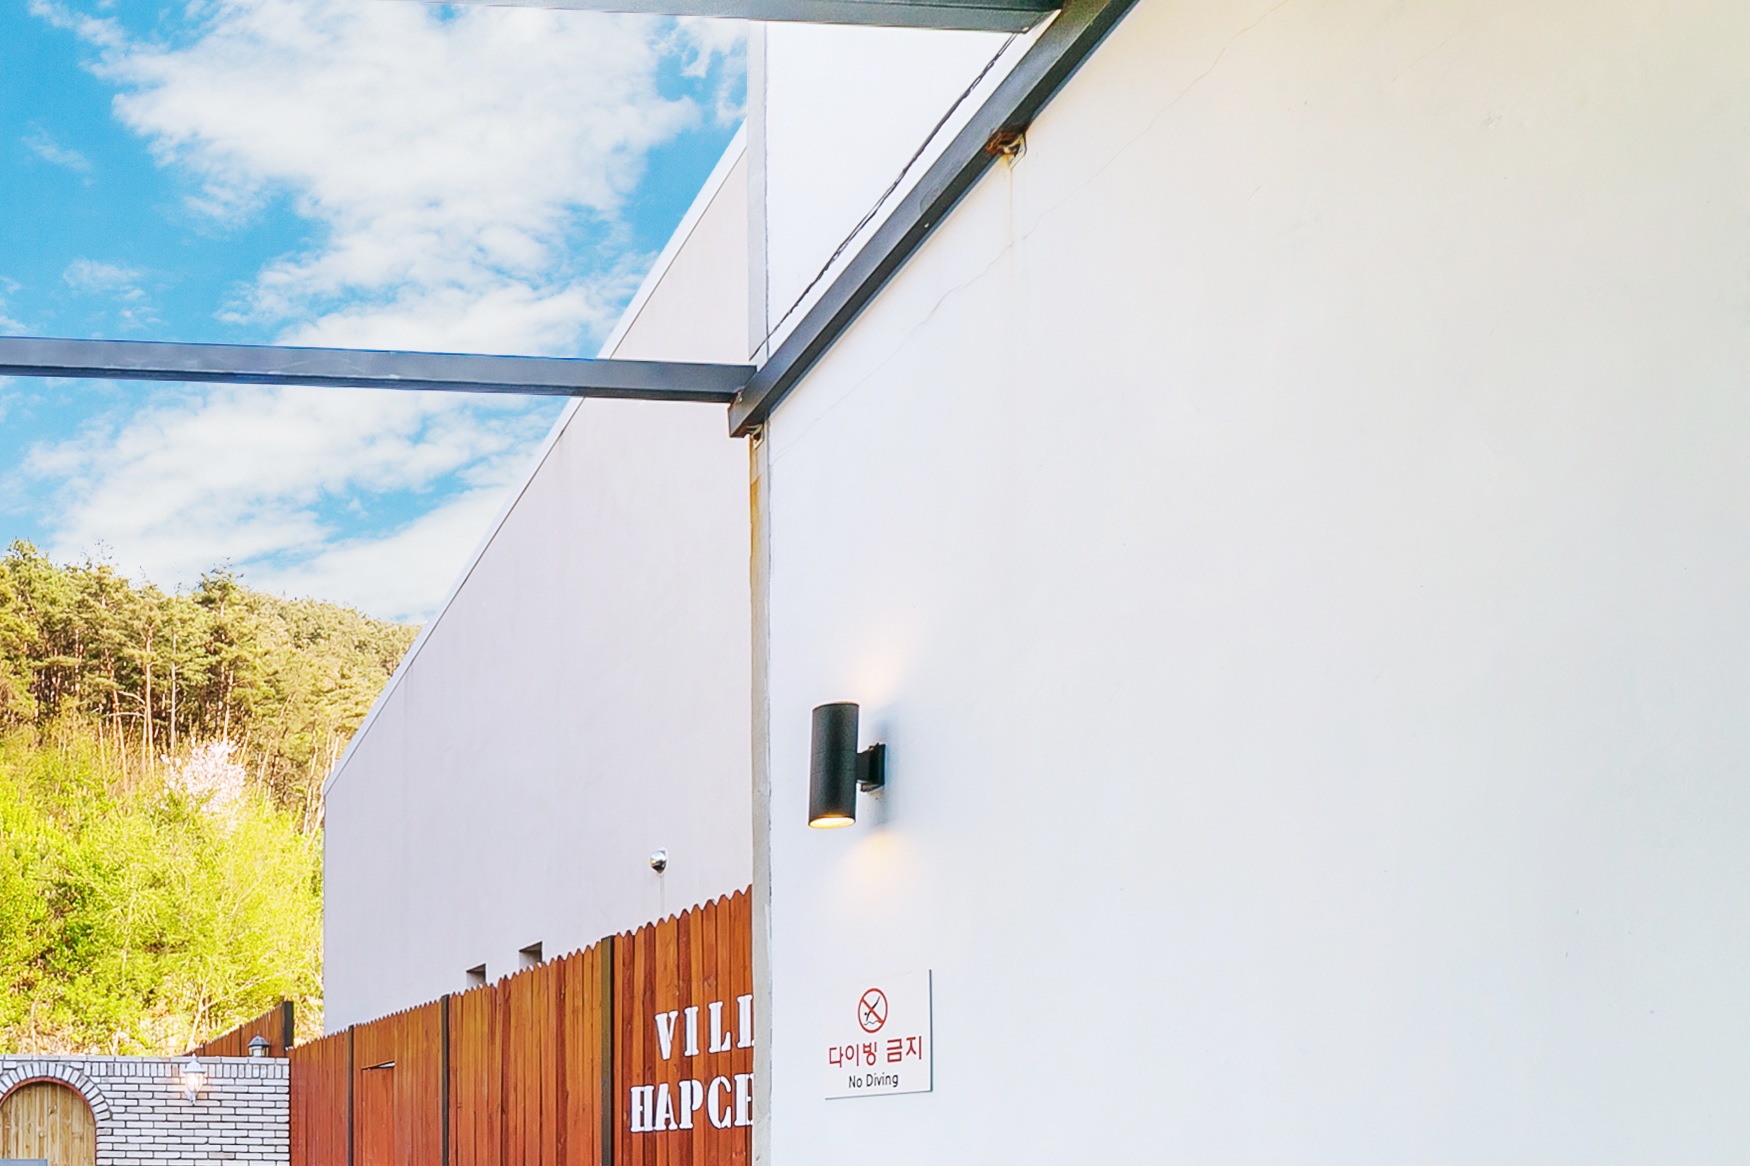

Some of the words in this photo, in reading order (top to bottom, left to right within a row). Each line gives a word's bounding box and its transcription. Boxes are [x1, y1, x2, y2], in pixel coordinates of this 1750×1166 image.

[828, 1041, 878, 1068] 다이빙
[886, 1035, 922, 1063] 금지
[848, 1075, 863, 1088] No
[866, 1071, 899, 1088] Diving
